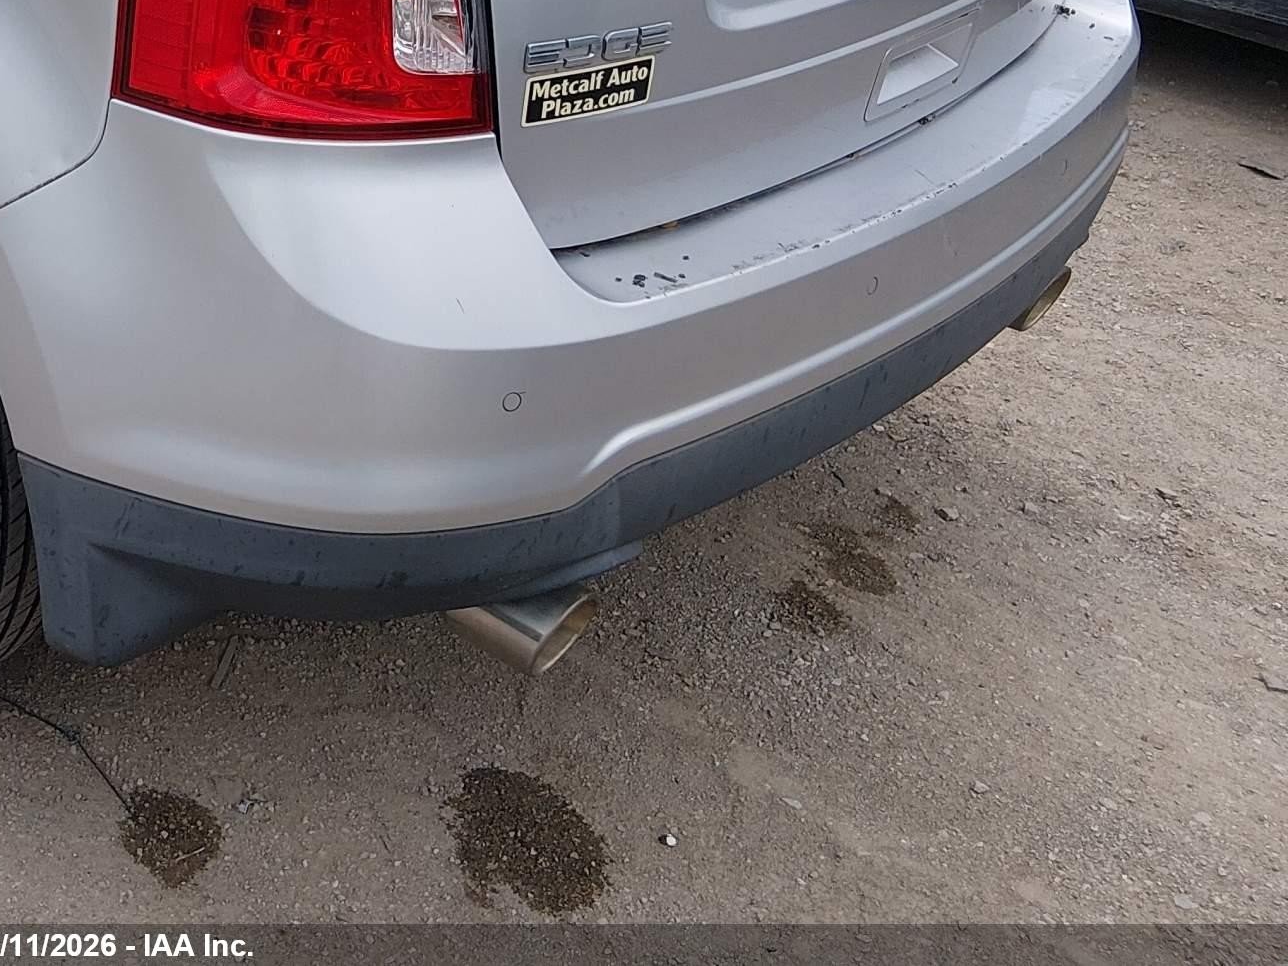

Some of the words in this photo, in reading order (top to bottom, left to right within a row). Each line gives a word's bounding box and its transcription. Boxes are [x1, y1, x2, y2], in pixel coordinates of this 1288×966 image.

[524, 21, 673, 73] EDGE
[531, 73, 604, 102] Metcalf
[608, 65, 649, 87] Auto
[540, 88, 636, 119] Plaza.com
